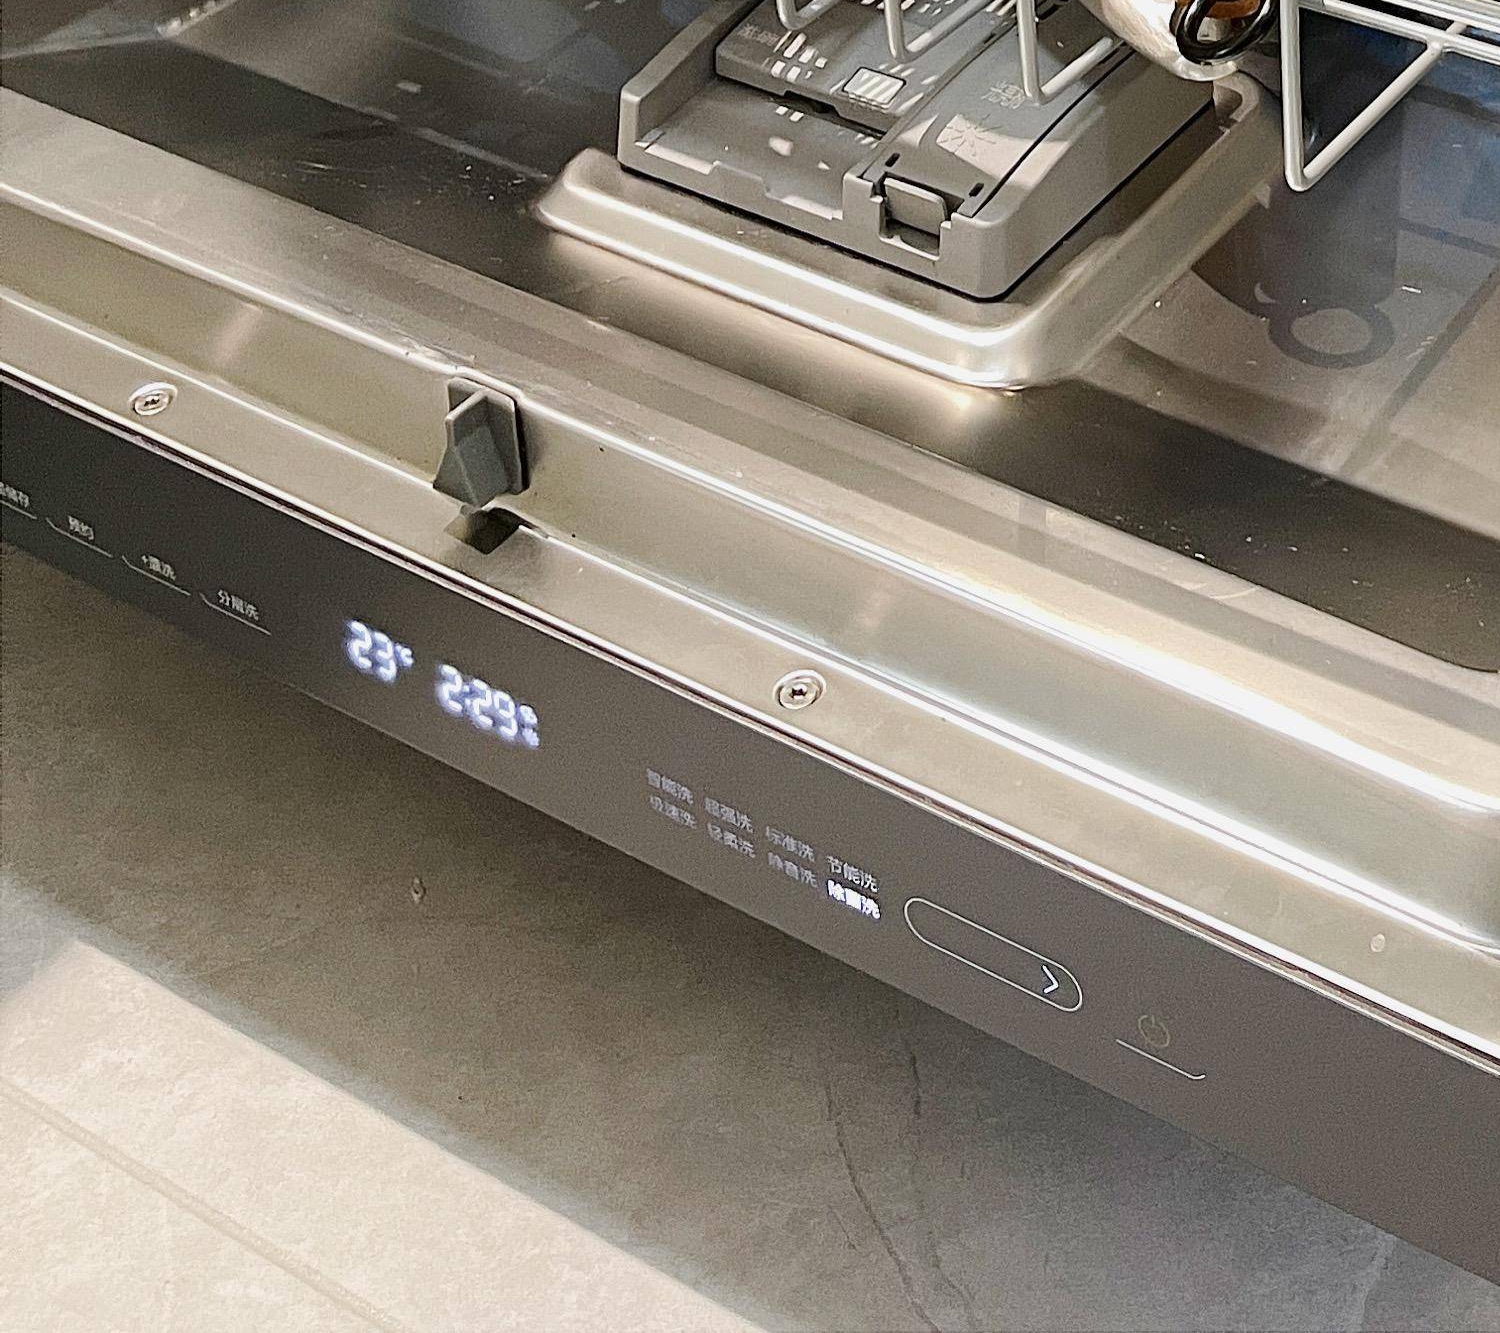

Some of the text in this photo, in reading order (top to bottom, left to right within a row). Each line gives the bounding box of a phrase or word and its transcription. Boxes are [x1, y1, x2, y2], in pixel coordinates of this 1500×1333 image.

[765, 825, 816, 863] 标准洗
[826, 854, 879, 893] 节能洗
